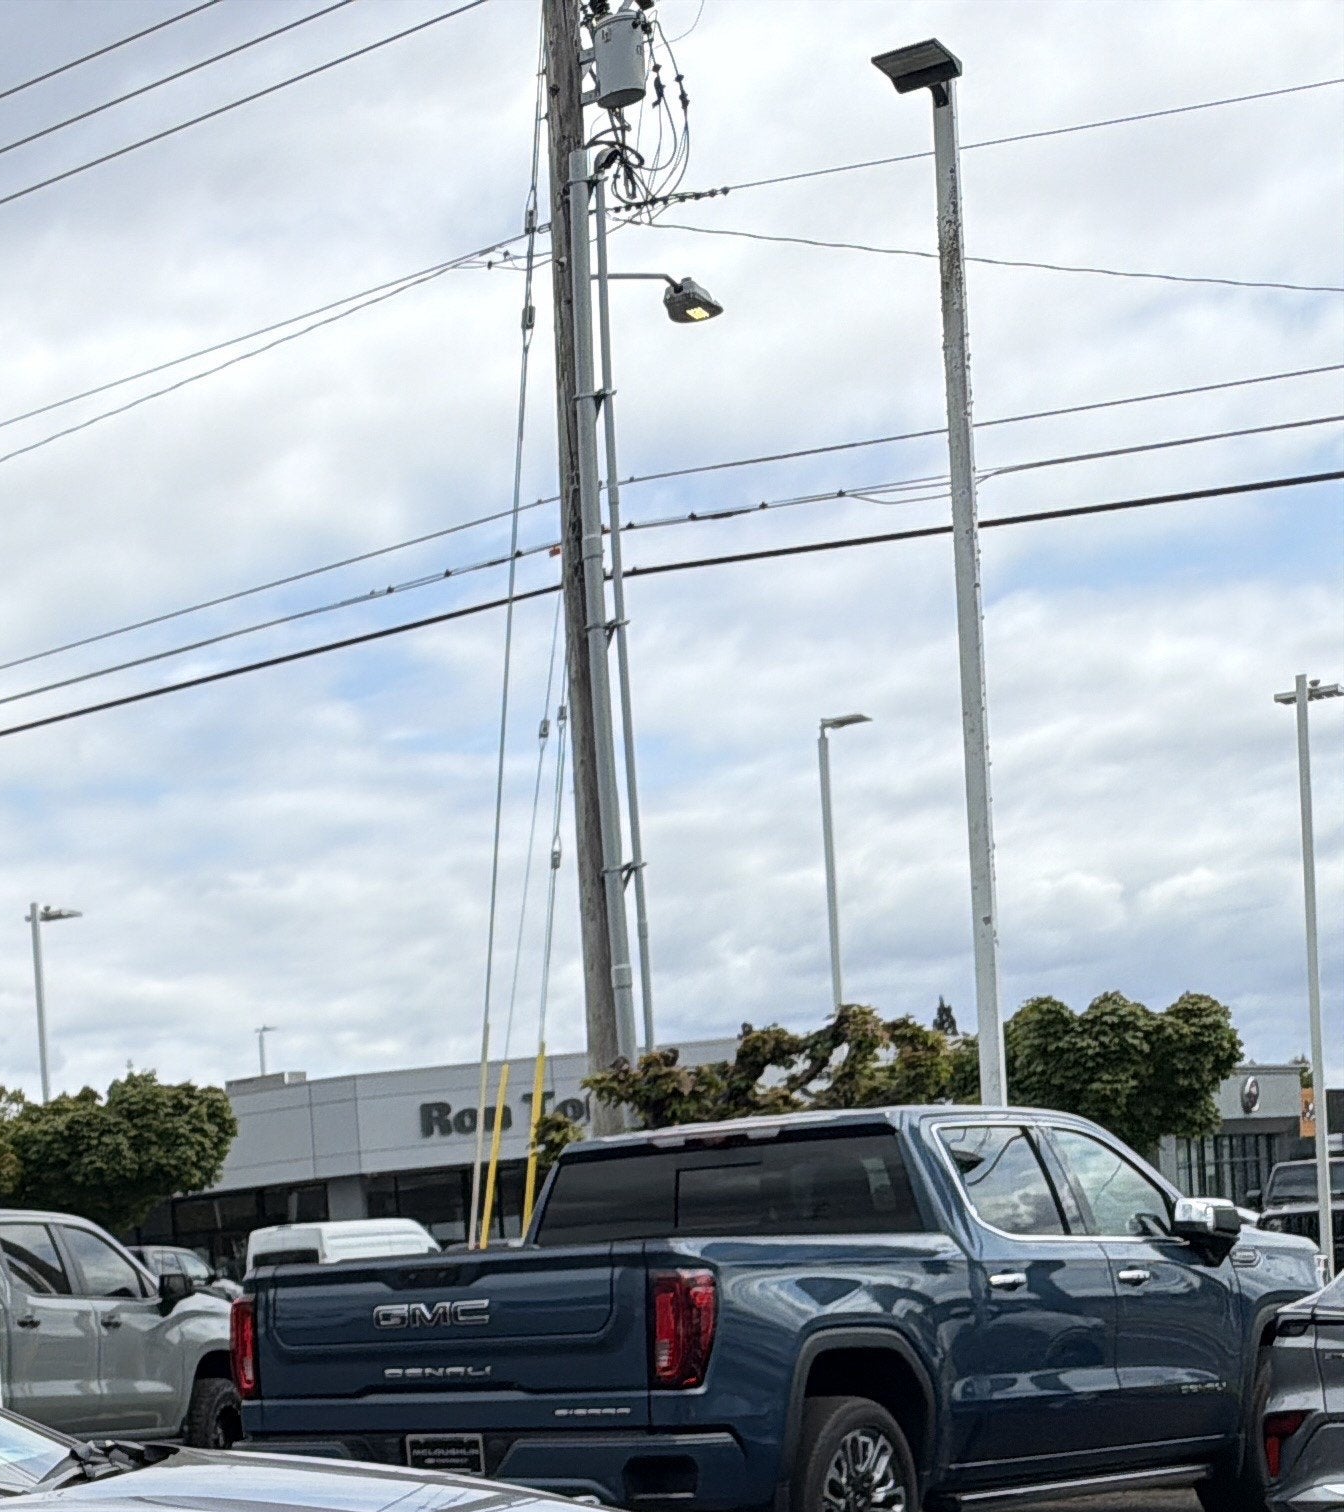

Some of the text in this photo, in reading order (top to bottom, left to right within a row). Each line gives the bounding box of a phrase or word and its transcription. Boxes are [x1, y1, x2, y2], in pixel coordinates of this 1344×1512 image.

[420, 1101, 512, 1138] Ron
[373, 1299, 489, 1329] GMC
[384, 1365, 491, 1378] DENALI
